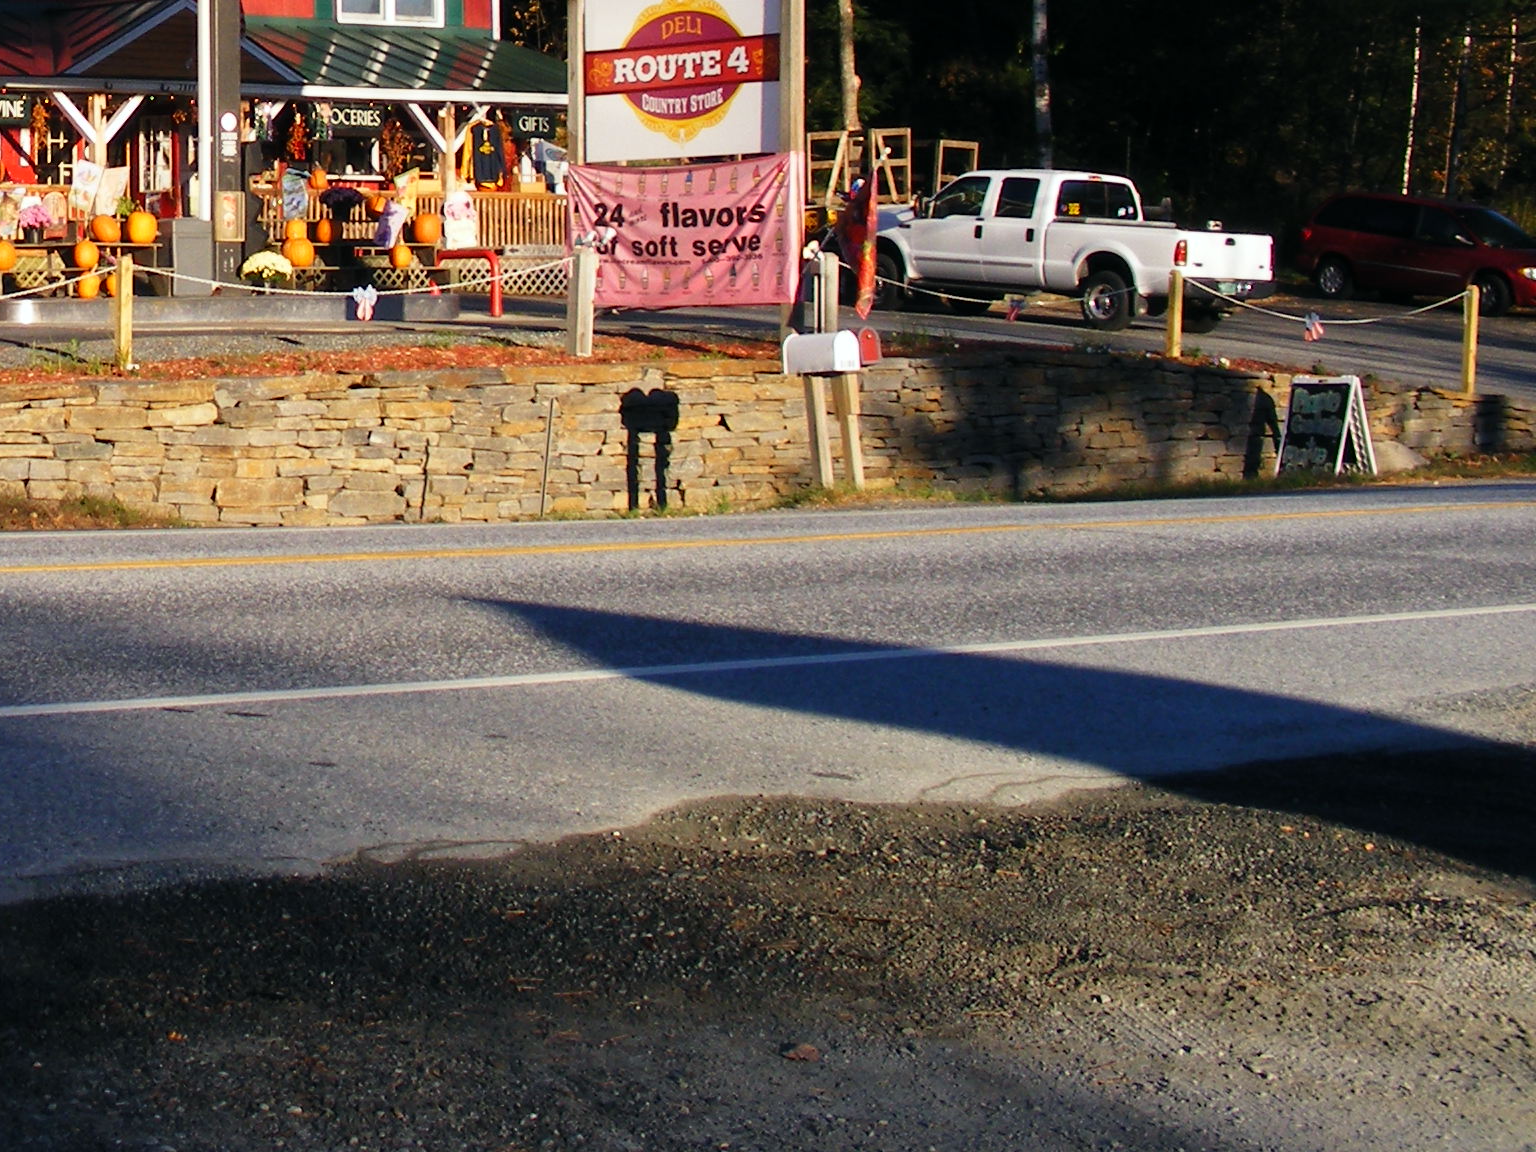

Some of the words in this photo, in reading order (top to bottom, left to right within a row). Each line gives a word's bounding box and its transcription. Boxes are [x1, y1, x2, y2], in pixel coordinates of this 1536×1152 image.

[661, 16, 702, 39] DELI
[613, 50, 721, 84] ROUTE
[727, 46, 749, 73] 4
[641, 93, 688, 114] COUNTRY
[690, 88, 724, 112] STORE
[331, 108, 381, 127] OCERIES
[518, 115, 550, 132] GIFTS
[593, 203, 625, 227] 24
[660, 201, 766, 228] flavors
[596, 235, 618, 256] of
[631, 235, 678, 257] soft
[692, 233, 761, 258] serve
